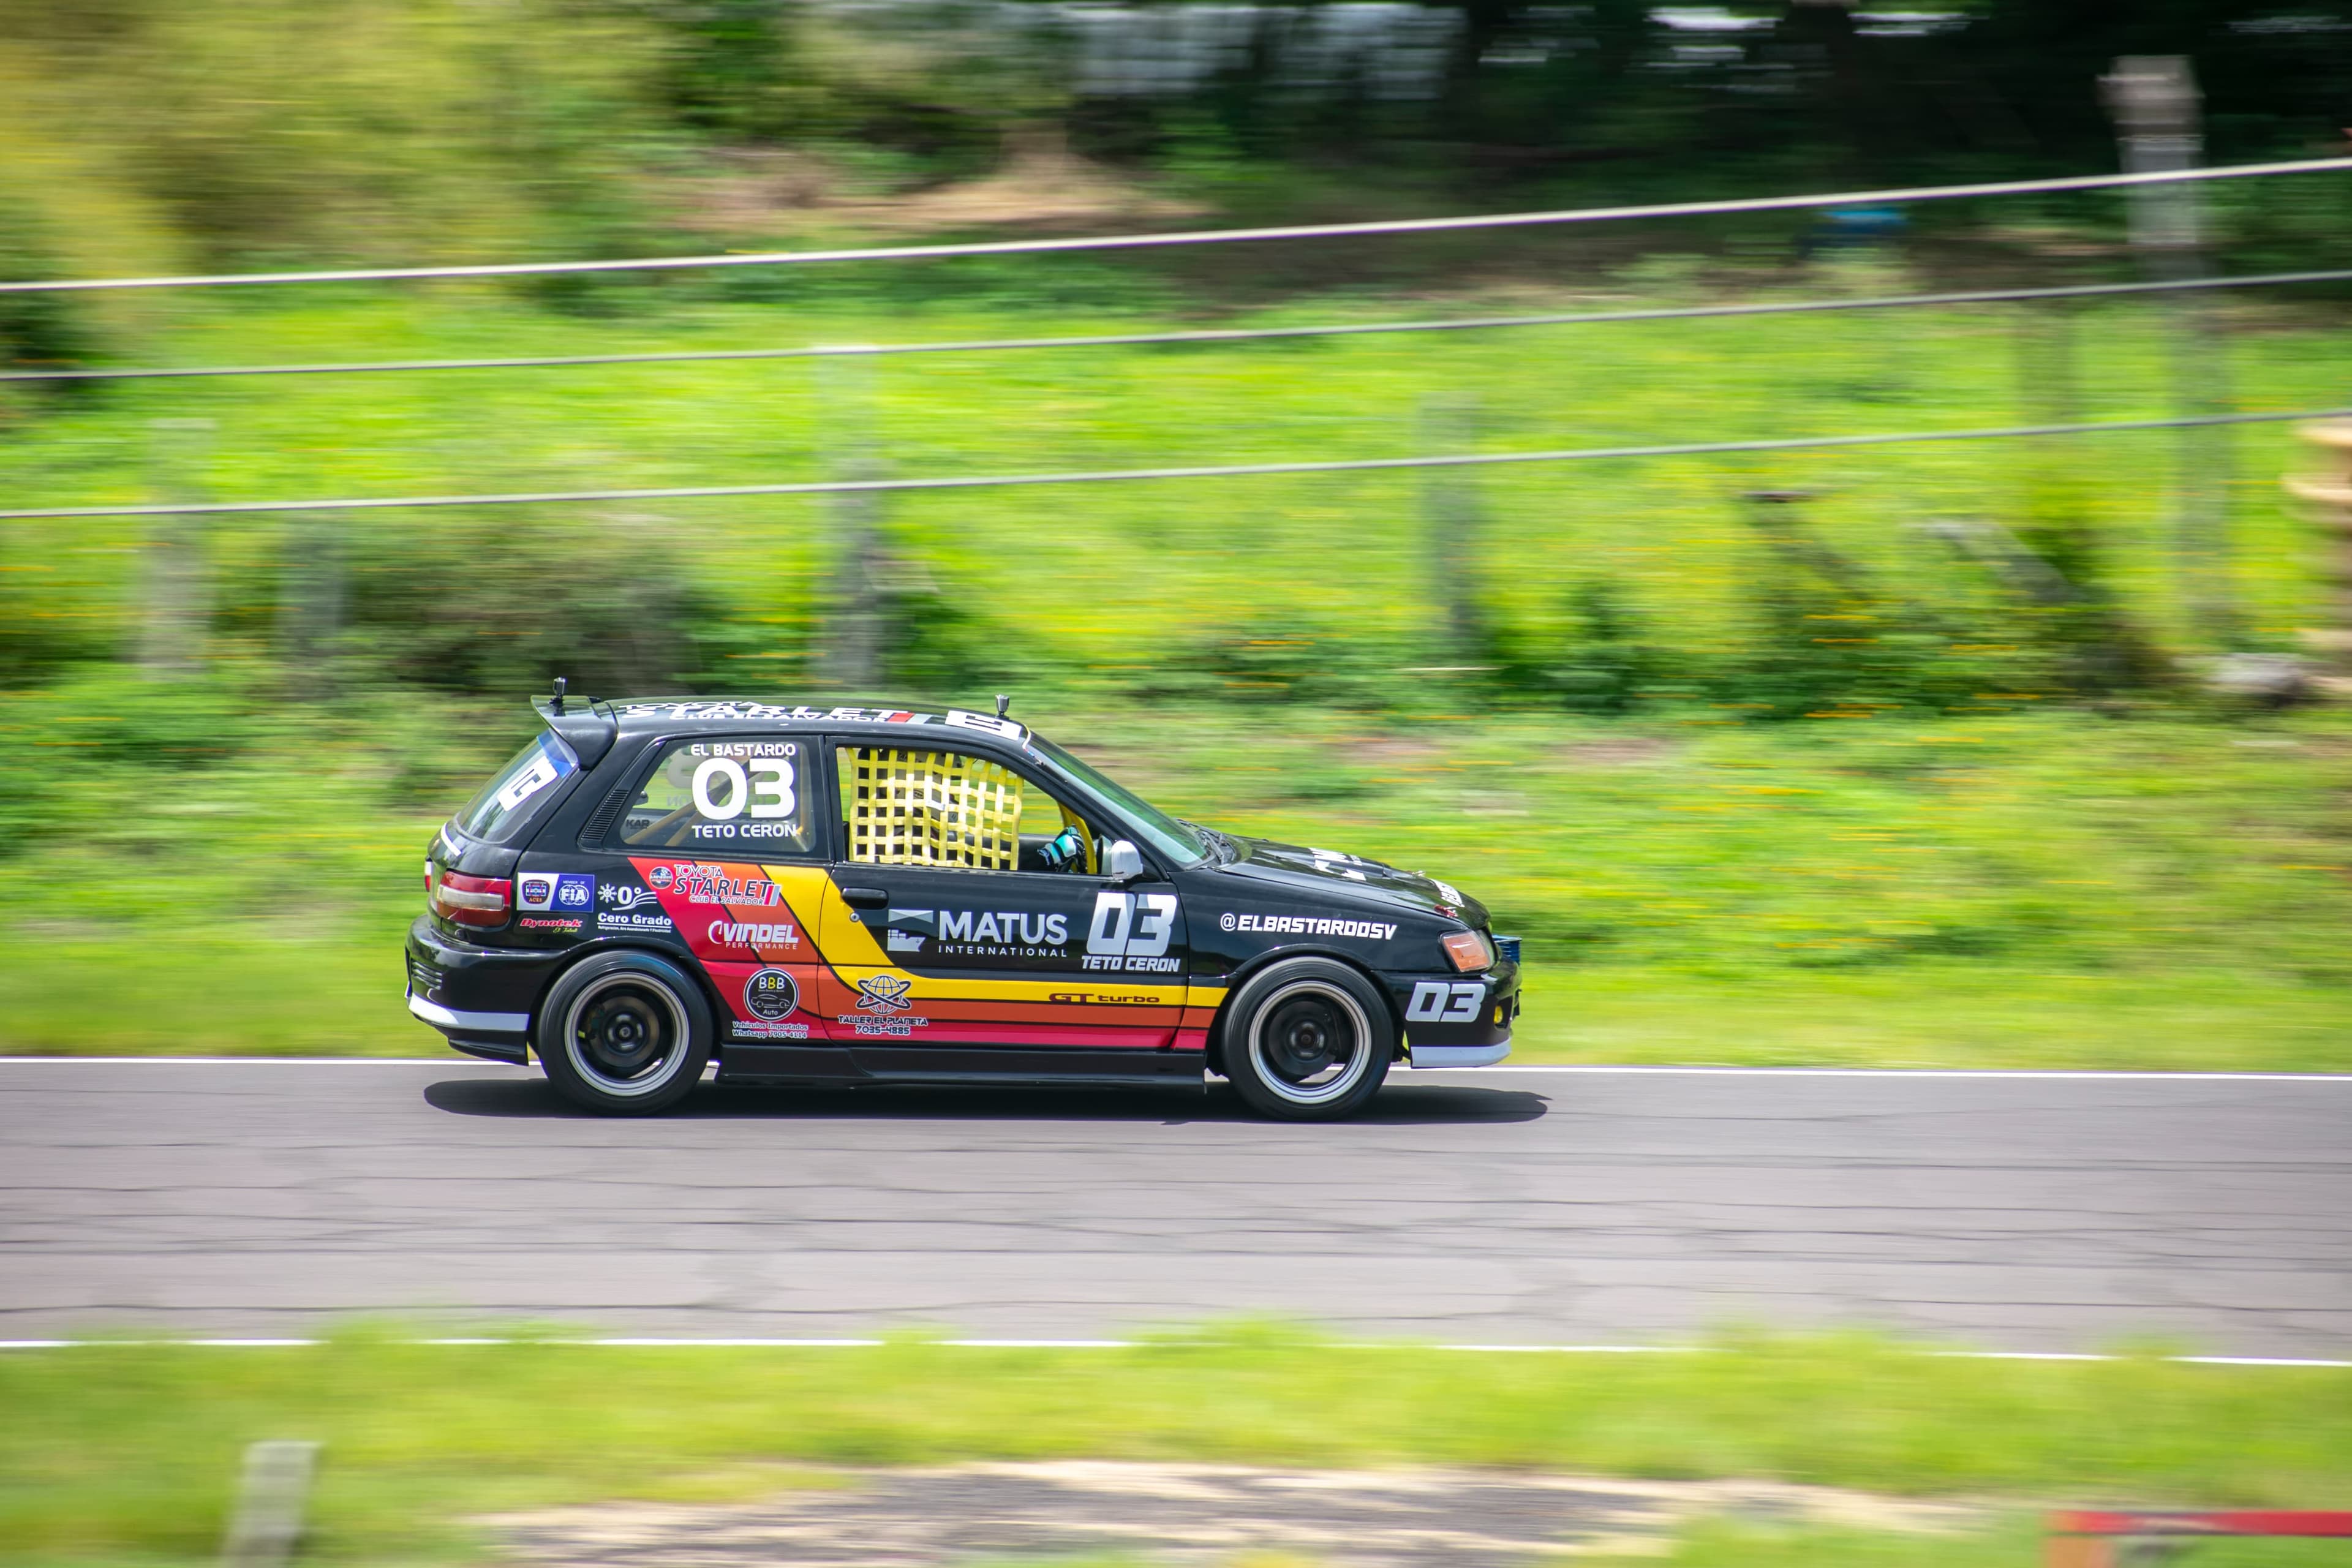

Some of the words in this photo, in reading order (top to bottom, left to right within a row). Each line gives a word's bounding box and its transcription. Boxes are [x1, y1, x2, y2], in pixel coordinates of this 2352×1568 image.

[619, 701, 762, 710] TOYOTA
[622, 705, 905, 719] STARLET
[690, 744, 709, 756] EL
[713, 744, 796, 756] BASTARDO
[692, 757, 796, 821] 03
[692, 825, 735, 838] TETO
[740, 824, 797, 838] CERON
[674, 864, 724, 878] TOYOTA
[674, 877, 773, 899] STARLET
[689, 895, 709, 903] CLUB
[710, 895, 720, 904] EL
[720, 896, 764, 905] SALVADOR
[519, 918, 582, 929] Dynotek
[597, 912, 629, 924] Cero
[631, 914, 672, 926] Grado
[1086, 891, 1178, 957] 03
[938, 910, 1068, 946] MATUS
[1219, 913, 1398, 940] @ELBASTARDOSV
[725, 941, 797, 950] PERFORMANCE
[938, 944, 1068, 958] INTERNATIONAL
[1082, 956, 1122, 970] TETO
[1125, 957, 1181, 973] CERON
[758, 976, 785, 990] BBB
[1049, 992, 1095, 1003] GT
[1405, 981, 1486, 1023] 03
[767, 1022, 809, 1031] Importados
[838, 1014, 873, 1024] TALLER
[873, 1016, 885, 1025] EL
[886, 1017, 928, 1026] PLANETA
[732, 1029, 767, 1039] Whatsapp
[768, 1030, 807, 1039] 7905-4114
[855, 1025, 911, 1036] 7035-4885
